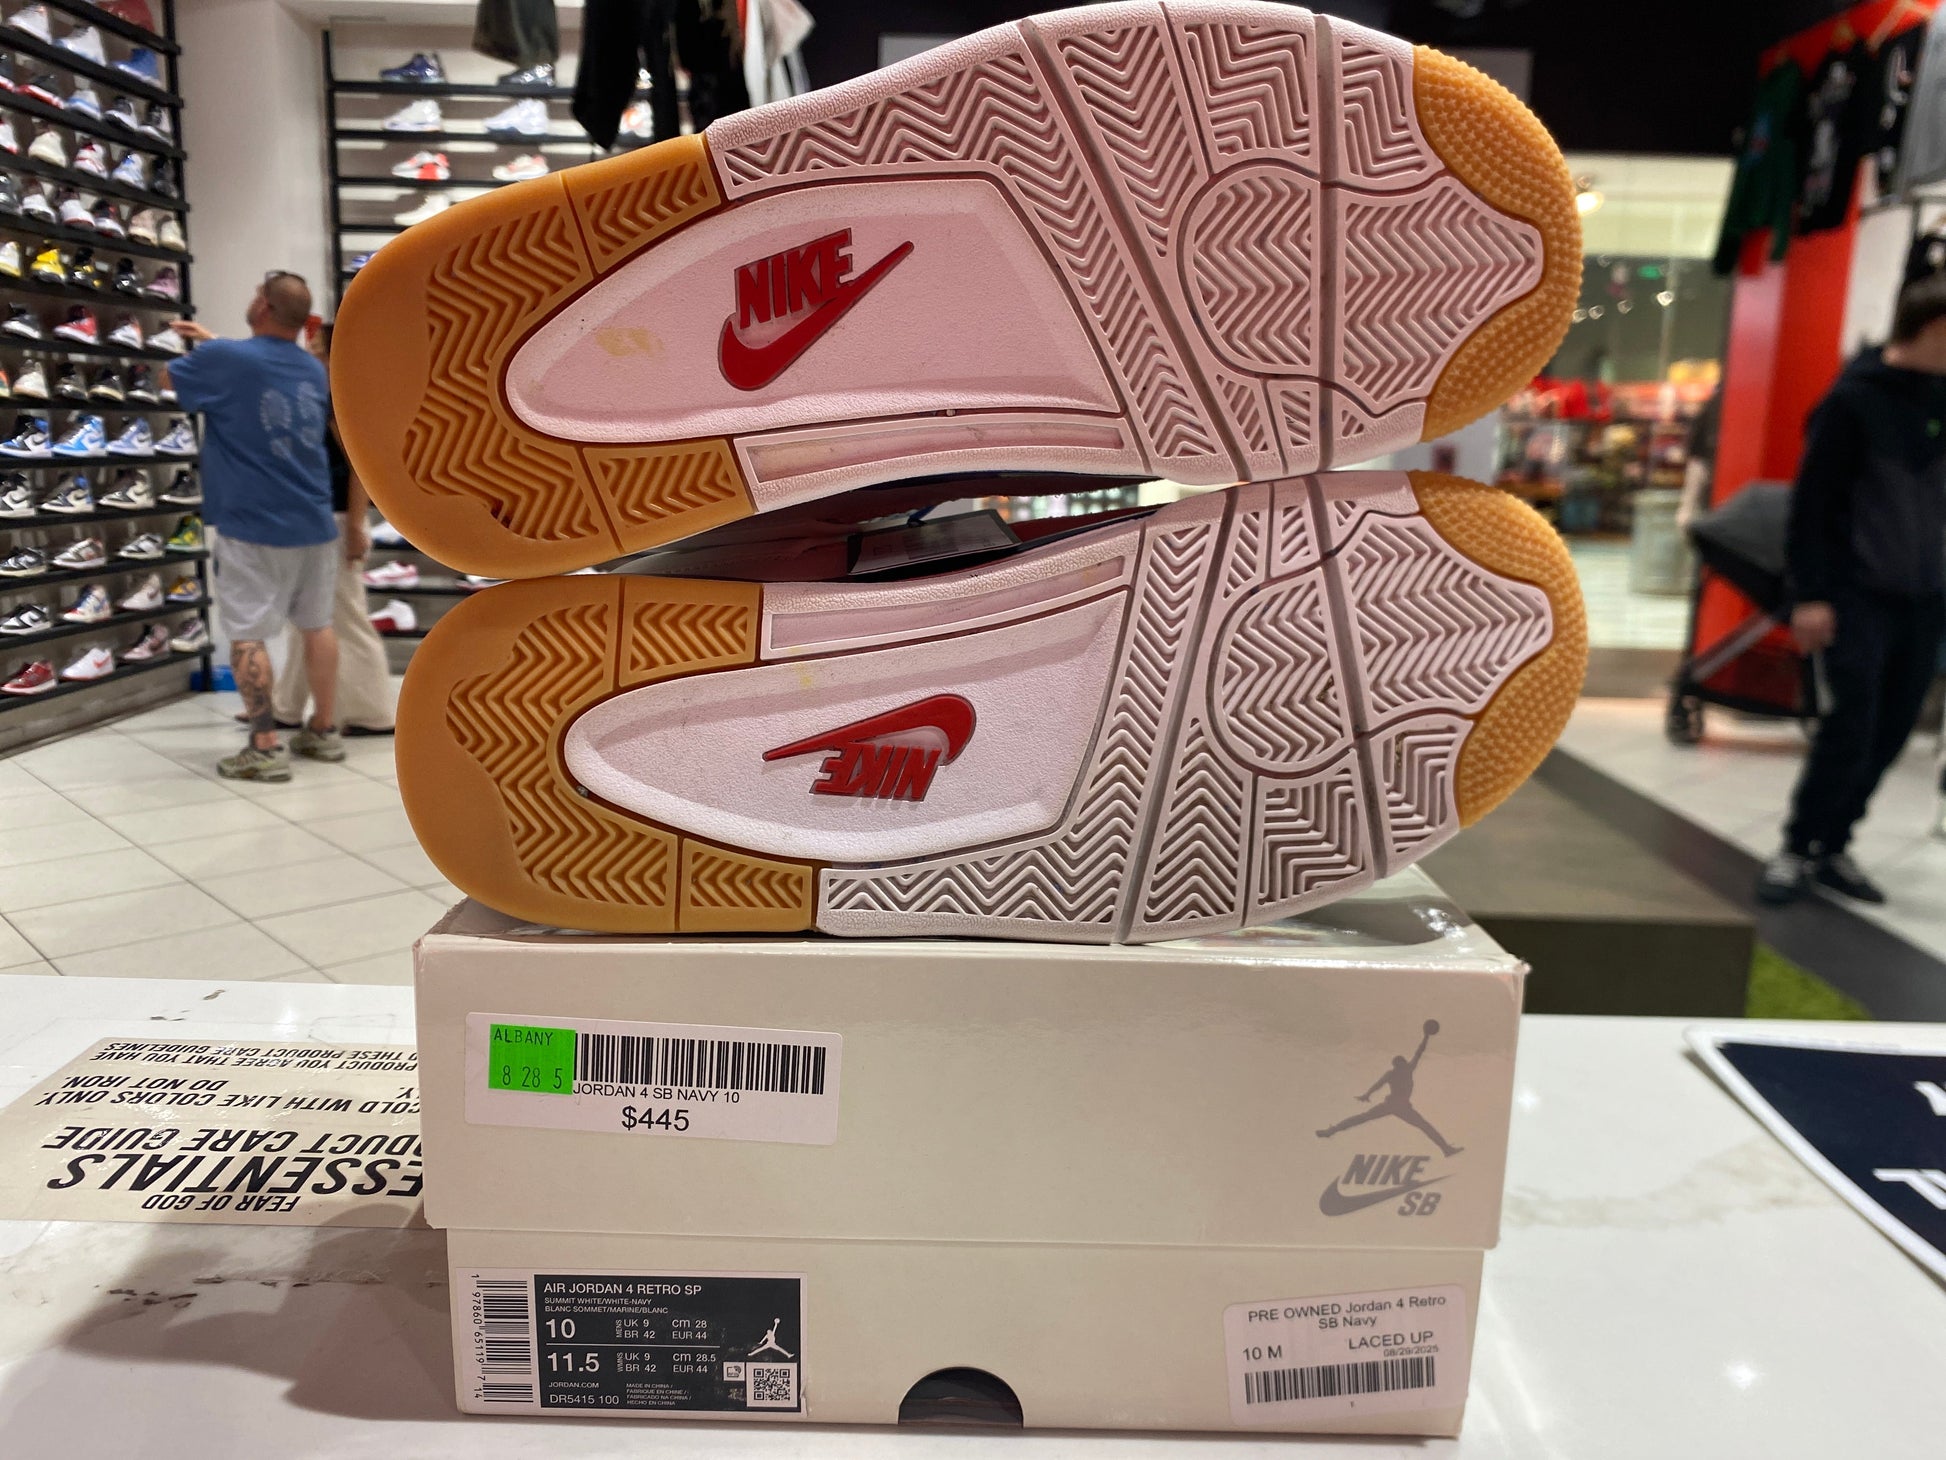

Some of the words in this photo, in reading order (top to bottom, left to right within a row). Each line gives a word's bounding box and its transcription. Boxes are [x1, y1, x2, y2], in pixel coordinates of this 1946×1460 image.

[734, 227, 853, 330] NIKE
[808, 741, 942, 802] NIKE
[493, 1027, 554, 1046] ALBANY
[89, 1051, 142, 1061] HAVE
[104, 1042, 211, 1054] GUIDELINES
[212, 1046, 261, 1057] CARE
[261, 1048, 347, 1059] PRODUCT
[347, 1050, 404, 1061] THESE
[141, 1052, 180, 1063] YOU
[182, 1054, 230, 1066] THAT
[231, 1057, 294, 1068] AGREE
[294, 1059, 332, 1069] YOU
[334, 1060, 418, 1071] PRODUCT
[61, 1075, 131, 1089] IRON.
[127, 1077, 188, 1091] NOT
[188, 1078, 229, 1091] DO
[502, 1064, 511, 1086] 8
[521, 1066, 541, 1088] 28
[552, 1067, 563, 1089] 5
[34, 1090, 110, 1107] ONLY.
[110, 1090, 217, 1107] COLORS
[216, 1093, 282, 1109] LIKE
[573, 1083, 636, 1098] JORDAN
[639, 1087, 649, 1099] 4
[652, 1087, 673, 1100] SB
[677, 1089, 719, 1102] NAVY
[724, 1091, 740, 1104] 10
[283, 1096, 353, 1112] WITH
[621, 1105, 690, 1132] $445
[40, 1126, 181, 1151] GUIDE
[179, 1128, 299, 1153] CARE
[46, 1153, 423, 1197] ESSENTIALS
[1341, 1153, 1431, 1186] NIKE
[141, 1194, 196, 1210] GOD
[195, 1195, 233, 1211] OF
[234, 1195, 301, 1213] FEAR
[1397, 1191, 1442, 1217] SB
[544, 1283, 566, 1294] AIR
[568, 1283, 623, 1294] JORDAN
[625, 1284, 634, 1294] 4
[637, 1284, 681, 1295] RETRO
[684, 1285, 702, 1295] SP
[471, 1291, 483, 1325] 97860
[572, 1306, 669, 1314] SOMMET/MARINE/BLANC
[1248, 1308, 1279, 1322] PRE
[1283, 1303, 1341, 1319] OWNED
[1345, 1299, 1392, 1314] Jordan
[1396, 1298, 1404, 1308] 4
[1408, 1296, 1447, 1308] Retro
[545, 1318, 576, 1339] 10
[623, 1319, 639, 1328] UK
[643, 1319, 650, 1328] 9
[695, 1320, 708, 1329] 28
[1318, 1317, 1338, 1329] SB
[1342, 1315, 1377, 1328] Navy
[624, 1330, 639, 1339] BR
[643, 1330, 656, 1339] 42
[672, 1331, 693, 1340] EUR
[695, 1331, 707, 1340] 44
[1348, 1333, 1406, 1350] LACED
[1410, 1330, 1434, 1344] UP
[474, 1331, 485, 1364] 65119
[1243, 1346, 1262, 1361] 10
[1267, 1345, 1282, 1360] M
[547, 1352, 600, 1373] 11.5
[624, 1352, 640, 1361] UK
[644, 1352, 651, 1361] 9
[696, 1353, 717, 1362] 28.5
[625, 1364, 640, 1372] BR
[644, 1364, 657, 1373] 42
[672, 1364, 694, 1374] EUR
[696, 1365, 708, 1374] 44
[549, 1394, 595, 1404] DR5415
[599, 1395, 620, 1405] 100
